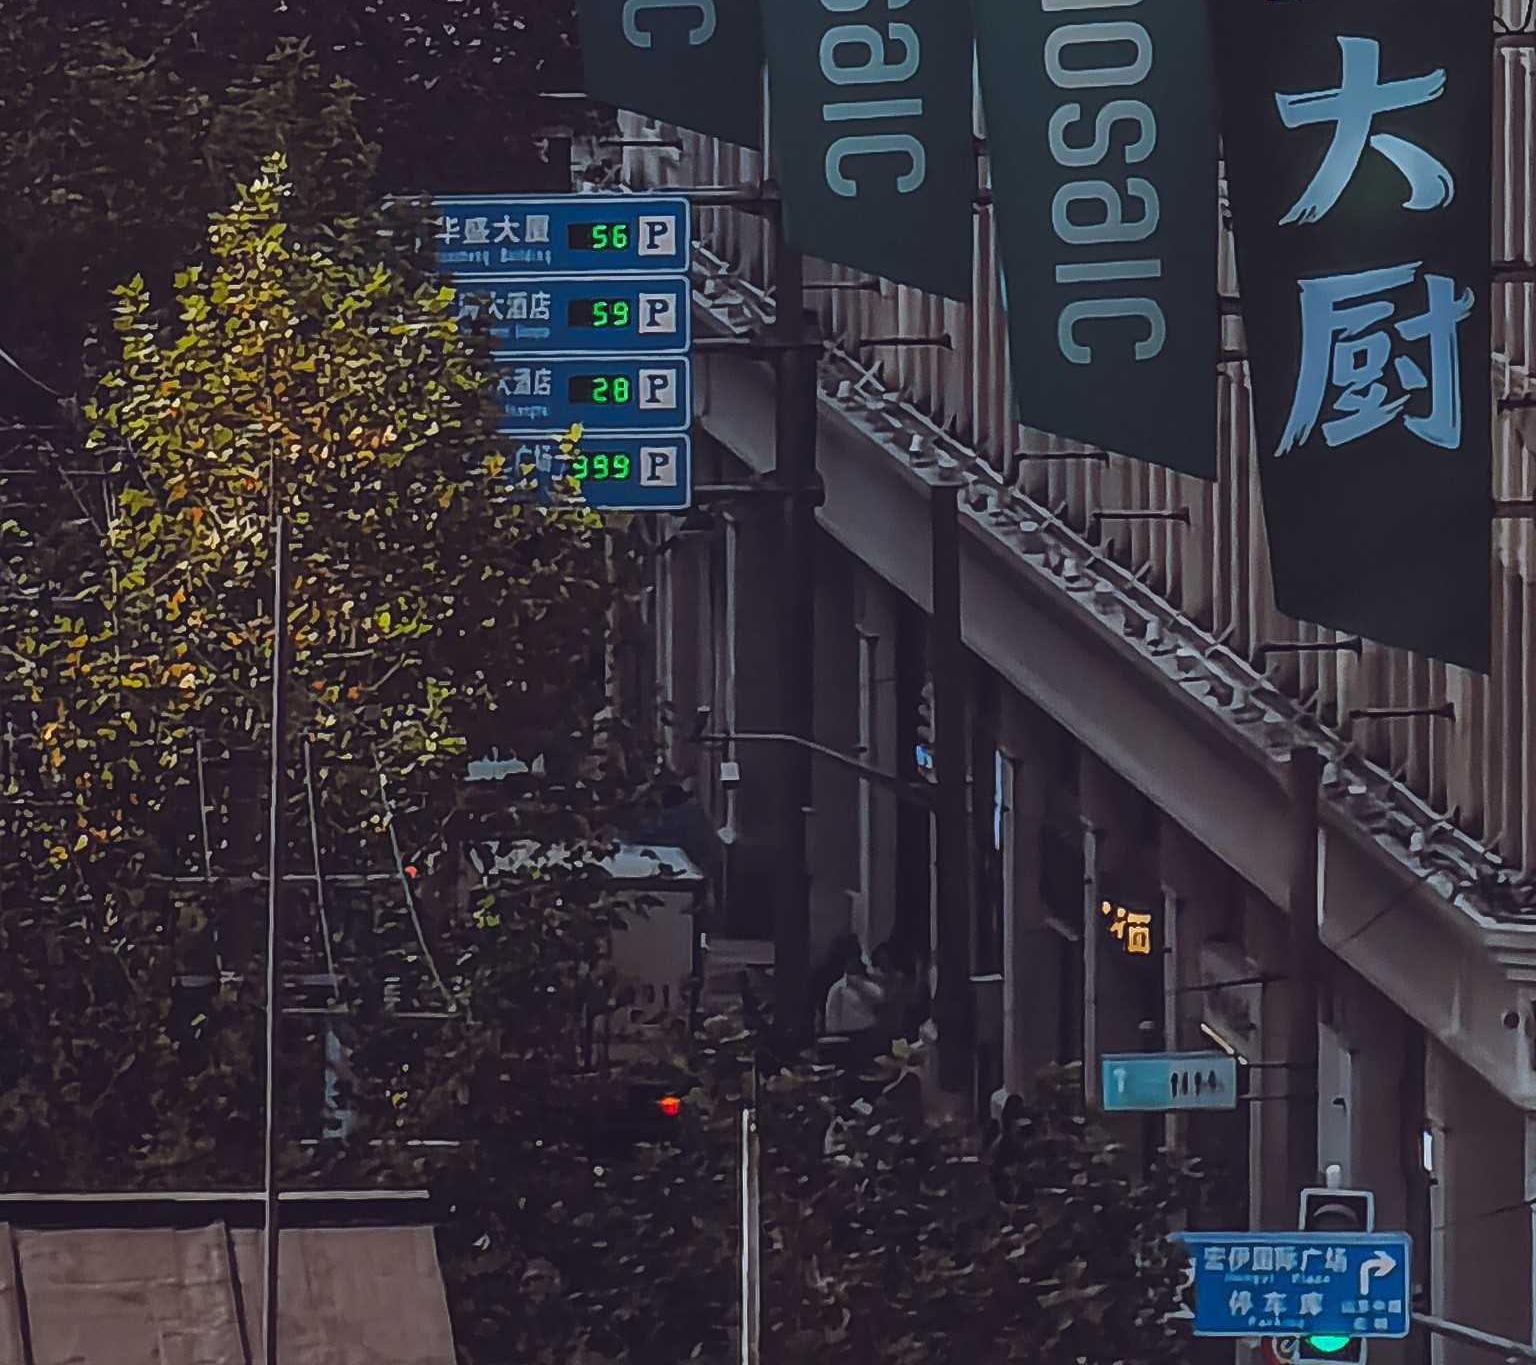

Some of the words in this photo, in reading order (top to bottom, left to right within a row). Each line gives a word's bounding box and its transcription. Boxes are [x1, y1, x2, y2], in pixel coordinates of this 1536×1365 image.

[591, 224, 629, 250] 56
[591, 301, 629, 327] 59
[591, 376, 630, 404] 28
